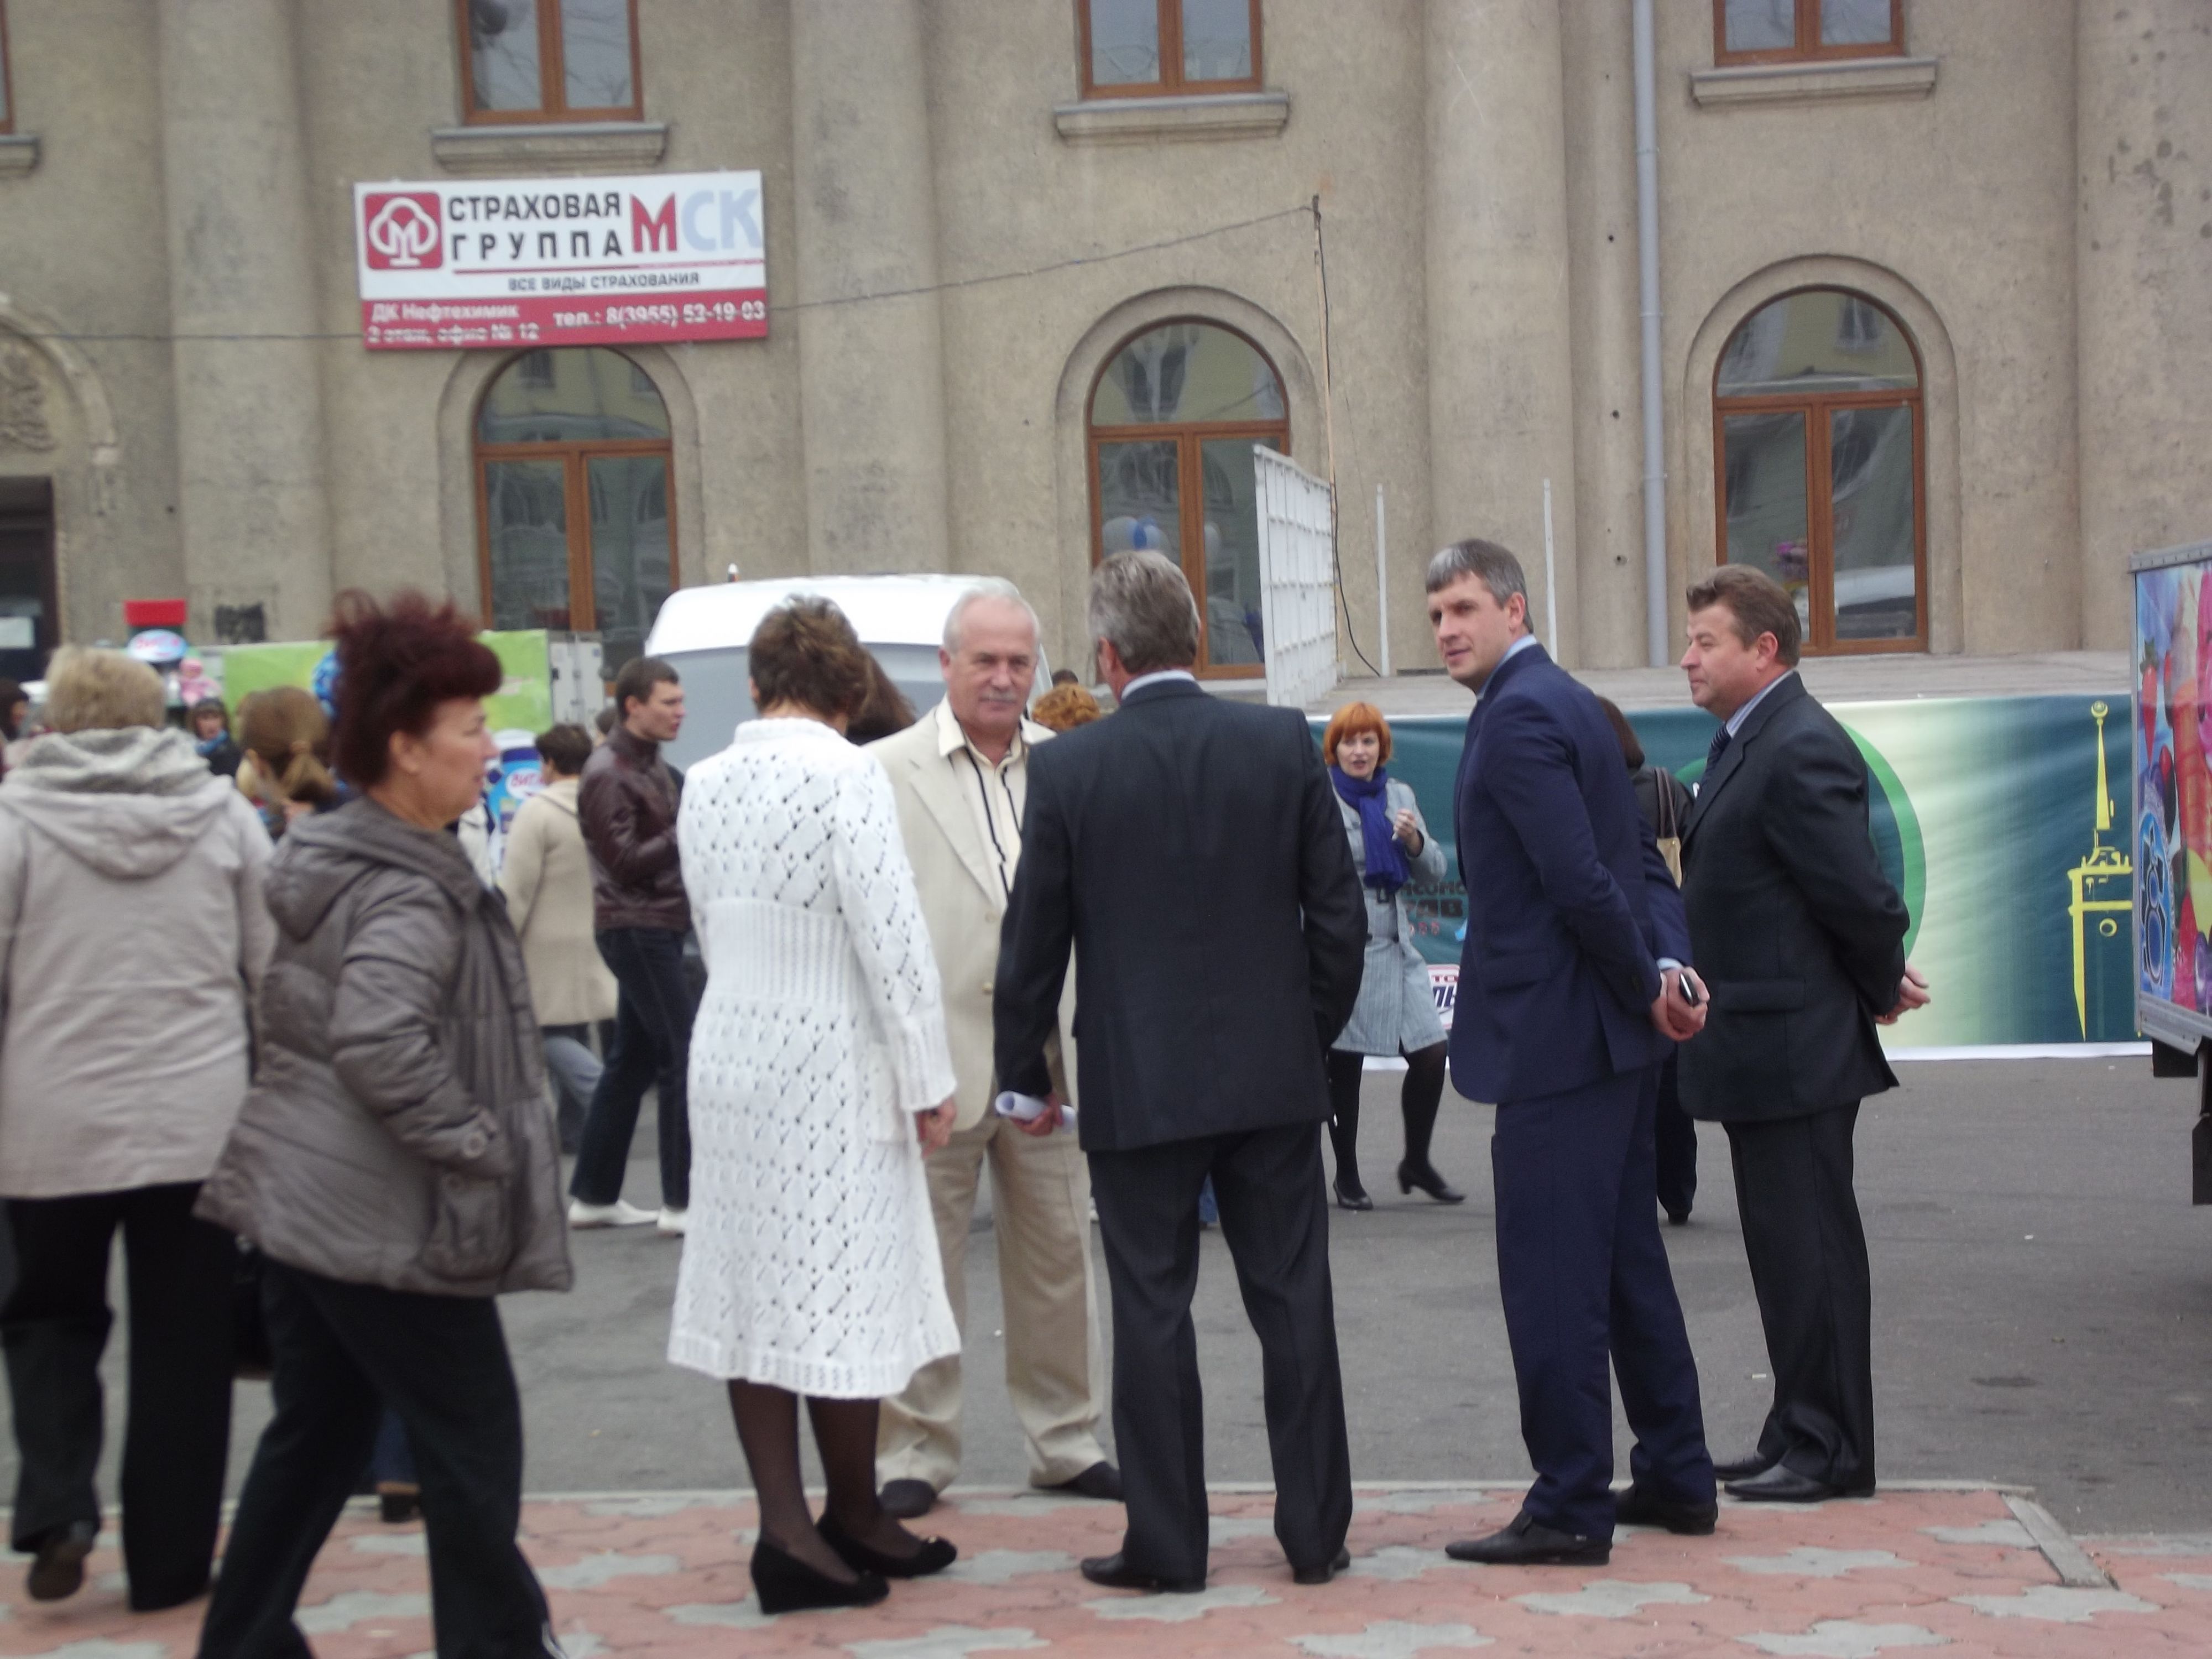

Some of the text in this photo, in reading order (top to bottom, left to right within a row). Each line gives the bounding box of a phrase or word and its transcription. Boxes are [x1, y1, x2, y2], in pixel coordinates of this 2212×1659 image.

[449, 192, 620, 221] СТРАХОВАЯ
[630, 189, 763, 252] МСК
[452, 229, 624, 261] ГРУППА
[508, 271, 699, 292] ВСЕ ВИДЫ СТРАХОВАНИЯ
[372, 303, 399, 322] ДК
[553, 311, 601, 327] тел.:
[606, 304, 678, 330] 8(3955)
